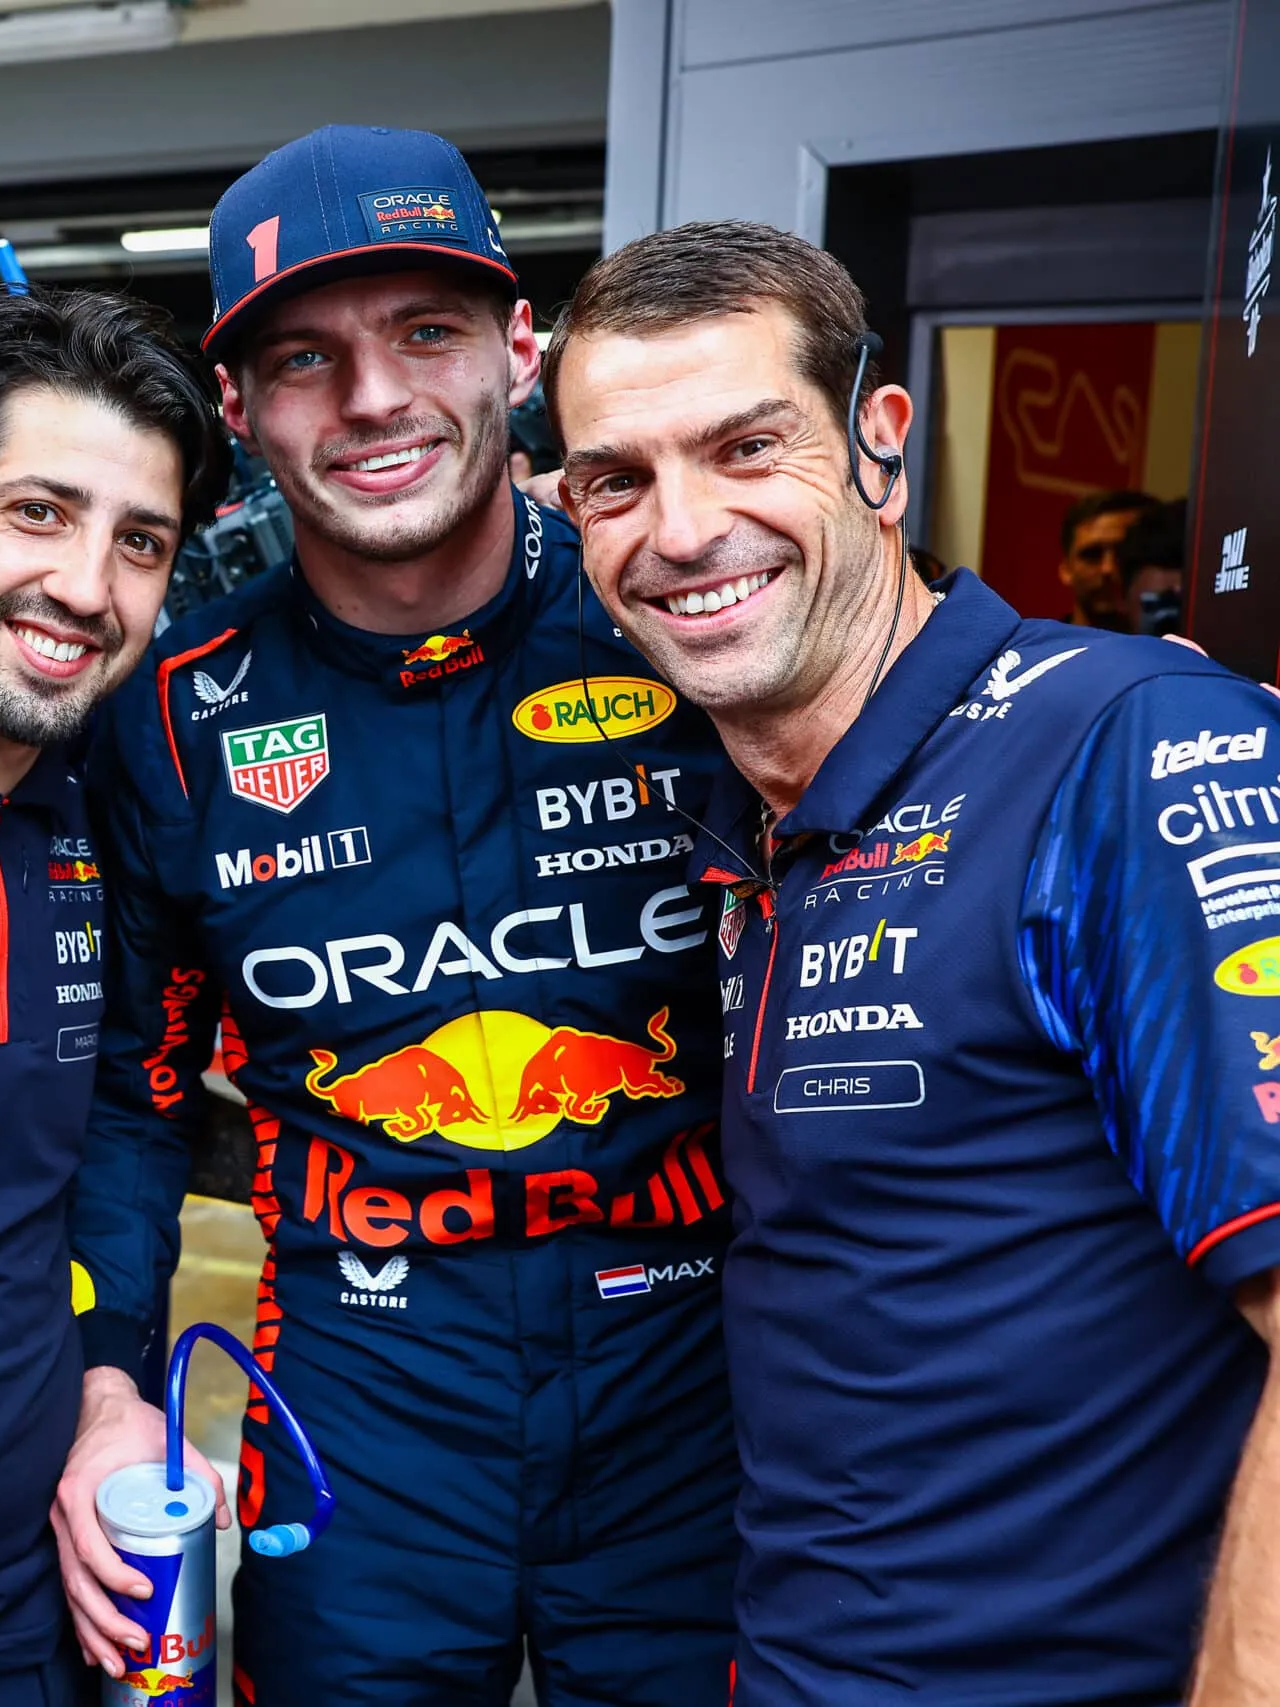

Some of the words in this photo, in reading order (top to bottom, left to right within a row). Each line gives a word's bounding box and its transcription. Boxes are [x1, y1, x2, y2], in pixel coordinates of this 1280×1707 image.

[373, 192, 451, 208] ORACLE
[377, 209, 400, 222] Red
[400, 206, 422, 219] Bull
[381, 221, 458, 234] RACING
[246, 215, 280, 283] 1
[400, 662, 442, 689] Red
[444, 645, 485, 677] Bull
[191, 690, 249, 722] CASTORE
[554, 690, 656, 728] RAUCH
[233, 722, 320, 762] TAG
[1150, 727, 1267, 780] telcel
[238, 755, 325, 805] HEUER
[535, 764, 681, 831] BYBIT
[1158, 774, 1280, 846] citri
[215, 835, 325, 889] Mobil
[534, 833, 695, 877] HONDA
[844, 842, 889, 871] Bull
[803, 868, 945, 910] RACING
[55, 921, 102, 966] BYBIT
[242, 884, 709, 1009] ORACLE
[800, 918, 918, 989] BYBIT
[56, 982, 103, 1004] HONDA
[785, 1003, 924, 1041] HONDA
[803, 1077, 871, 1097] CHRIS
[303, 1134, 494, 1248] Red
[525, 1122, 725, 1239] Bull
[648, 1256, 714, 1284] MAX
[340, 1292, 407, 1309] CASTORE
